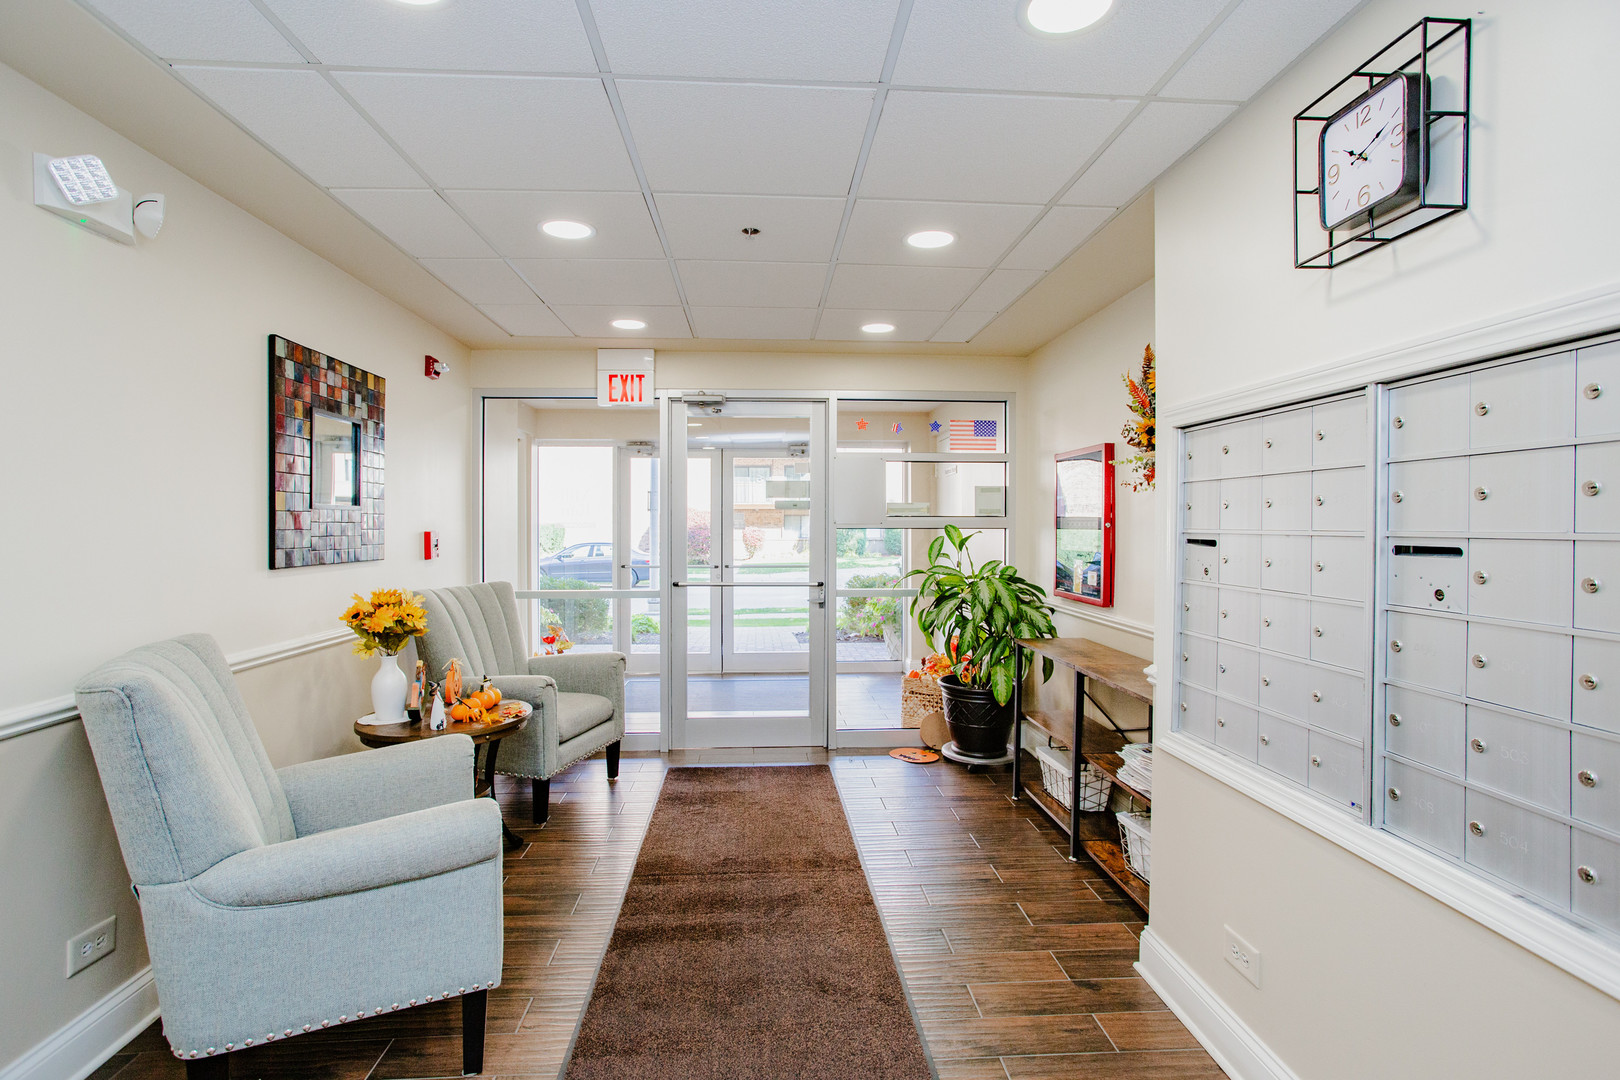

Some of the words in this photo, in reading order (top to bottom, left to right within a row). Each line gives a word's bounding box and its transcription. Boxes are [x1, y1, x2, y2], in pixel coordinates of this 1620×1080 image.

[1355, 104, 1371, 129] 12
[1390, 122, 1404, 148] 3
[1327, 163, 1340, 186] 9
[1357, 184, 1371, 208] 6
[608, 373, 645, 402] EXIT
